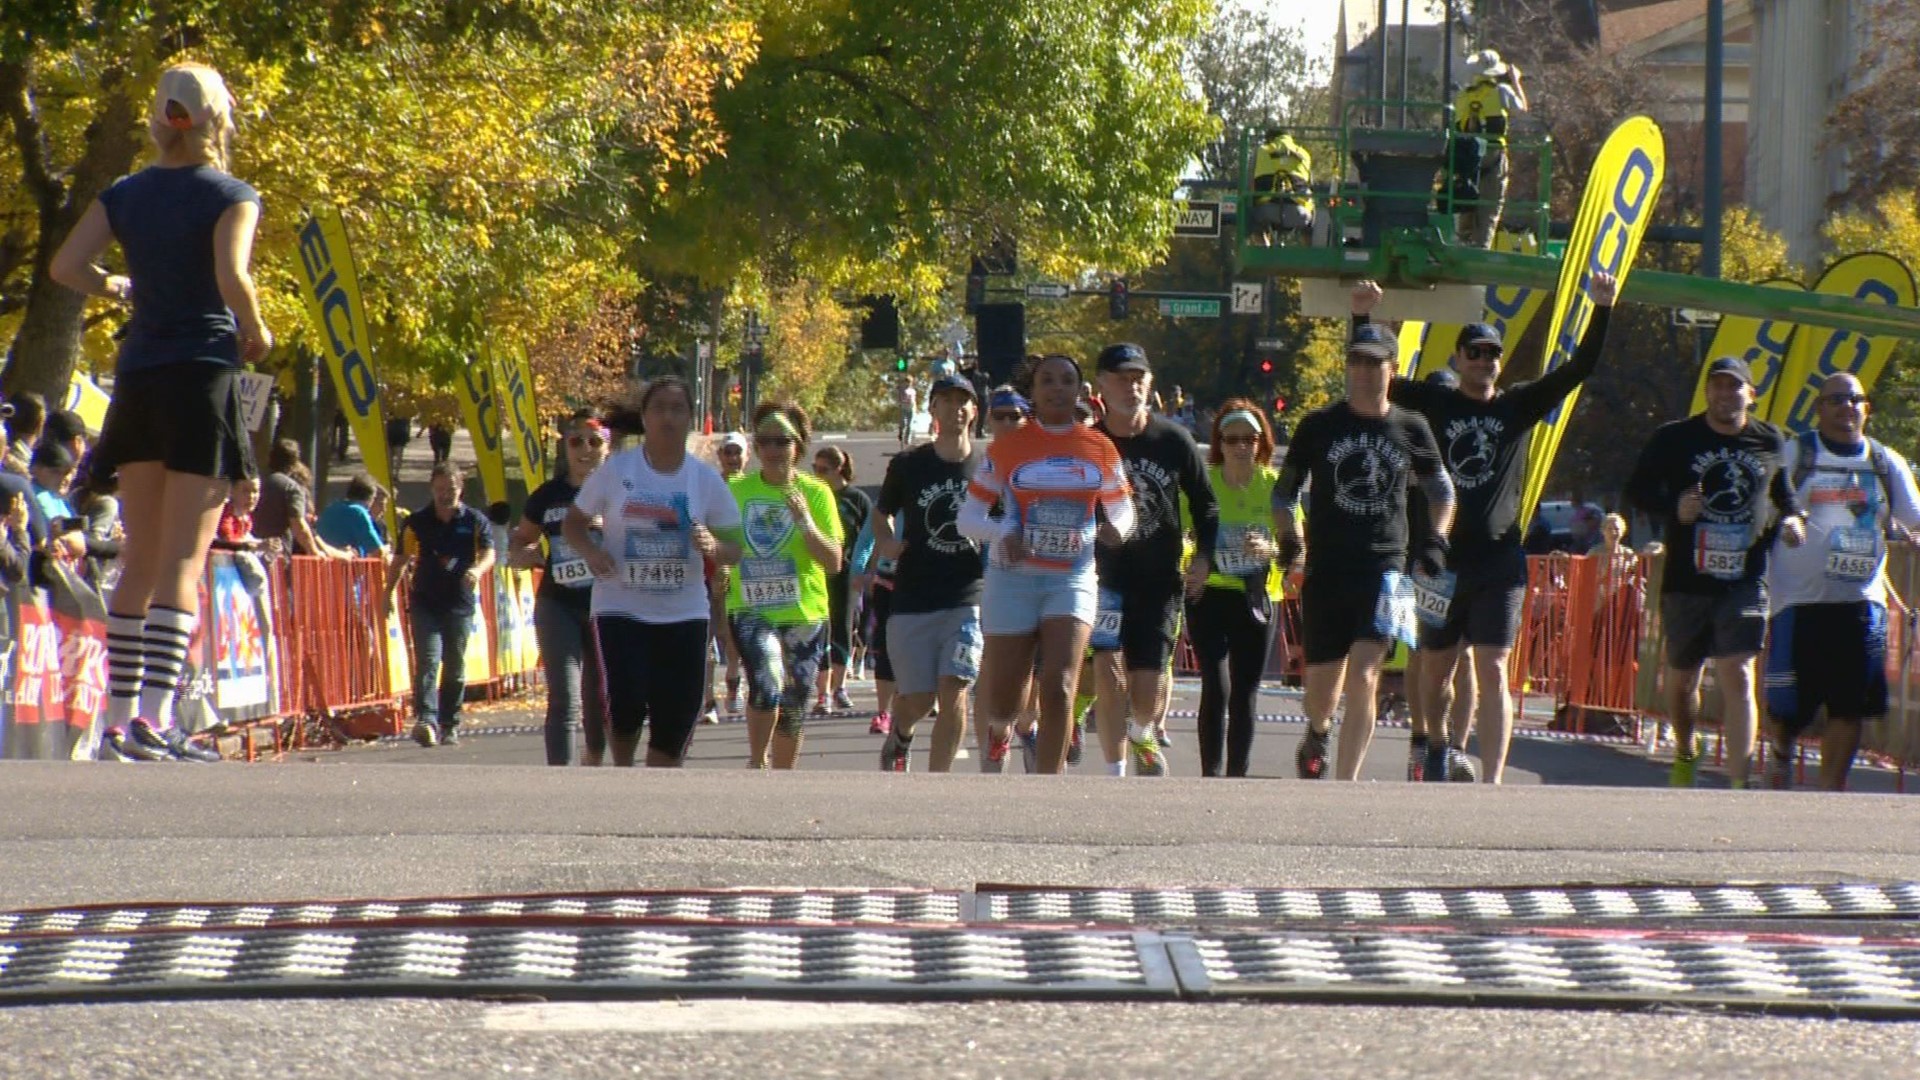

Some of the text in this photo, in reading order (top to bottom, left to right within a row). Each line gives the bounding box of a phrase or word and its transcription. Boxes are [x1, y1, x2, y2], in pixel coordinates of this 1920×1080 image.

[301, 216, 377, 417] EICO
[1173, 303, 1202, 313] Grant
[557, 562, 588, 580] 183
